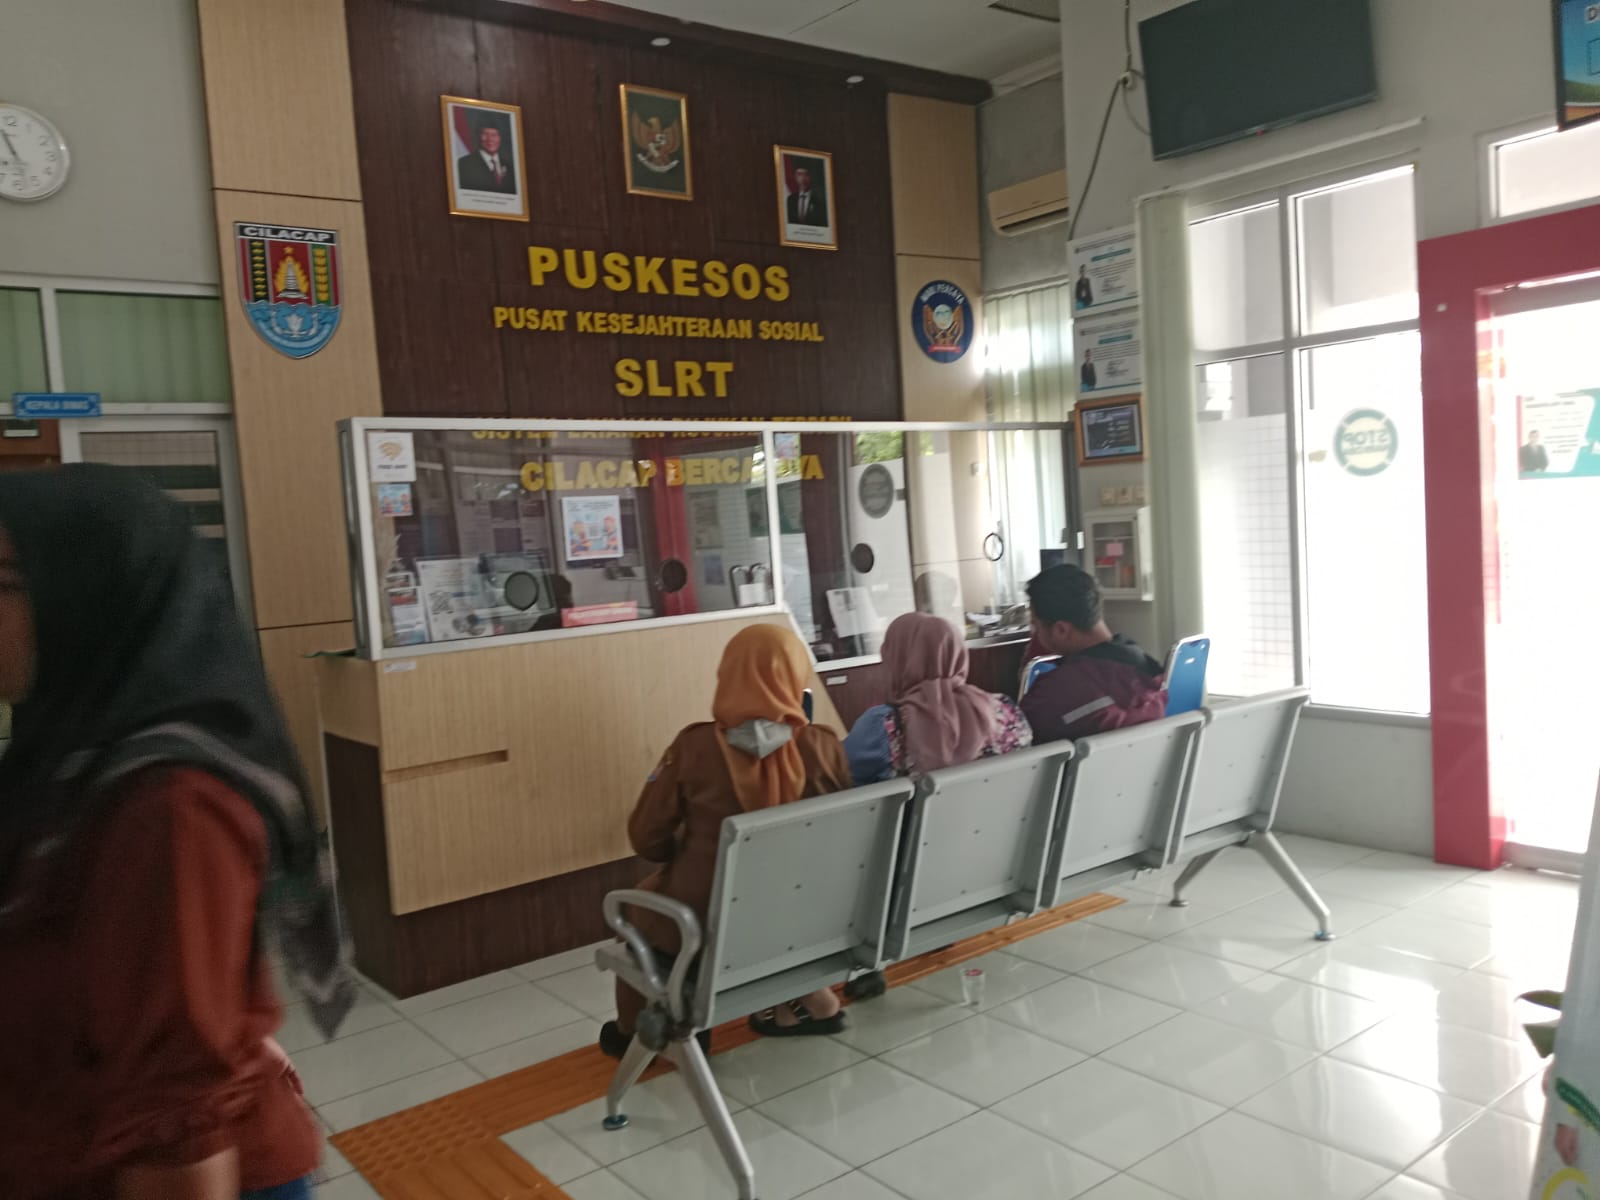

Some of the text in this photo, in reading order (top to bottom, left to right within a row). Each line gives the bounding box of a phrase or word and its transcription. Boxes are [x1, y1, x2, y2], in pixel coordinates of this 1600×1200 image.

[243, 226, 331, 242] CILACAP
[527, 245, 791, 302] PUSKESOS
[493, 306, 825, 343] PUSAT KESEJAHTERAAN SOSIAL
[614, 357, 735, 398] SLRT
[519, 457, 658, 492] CILACAP
